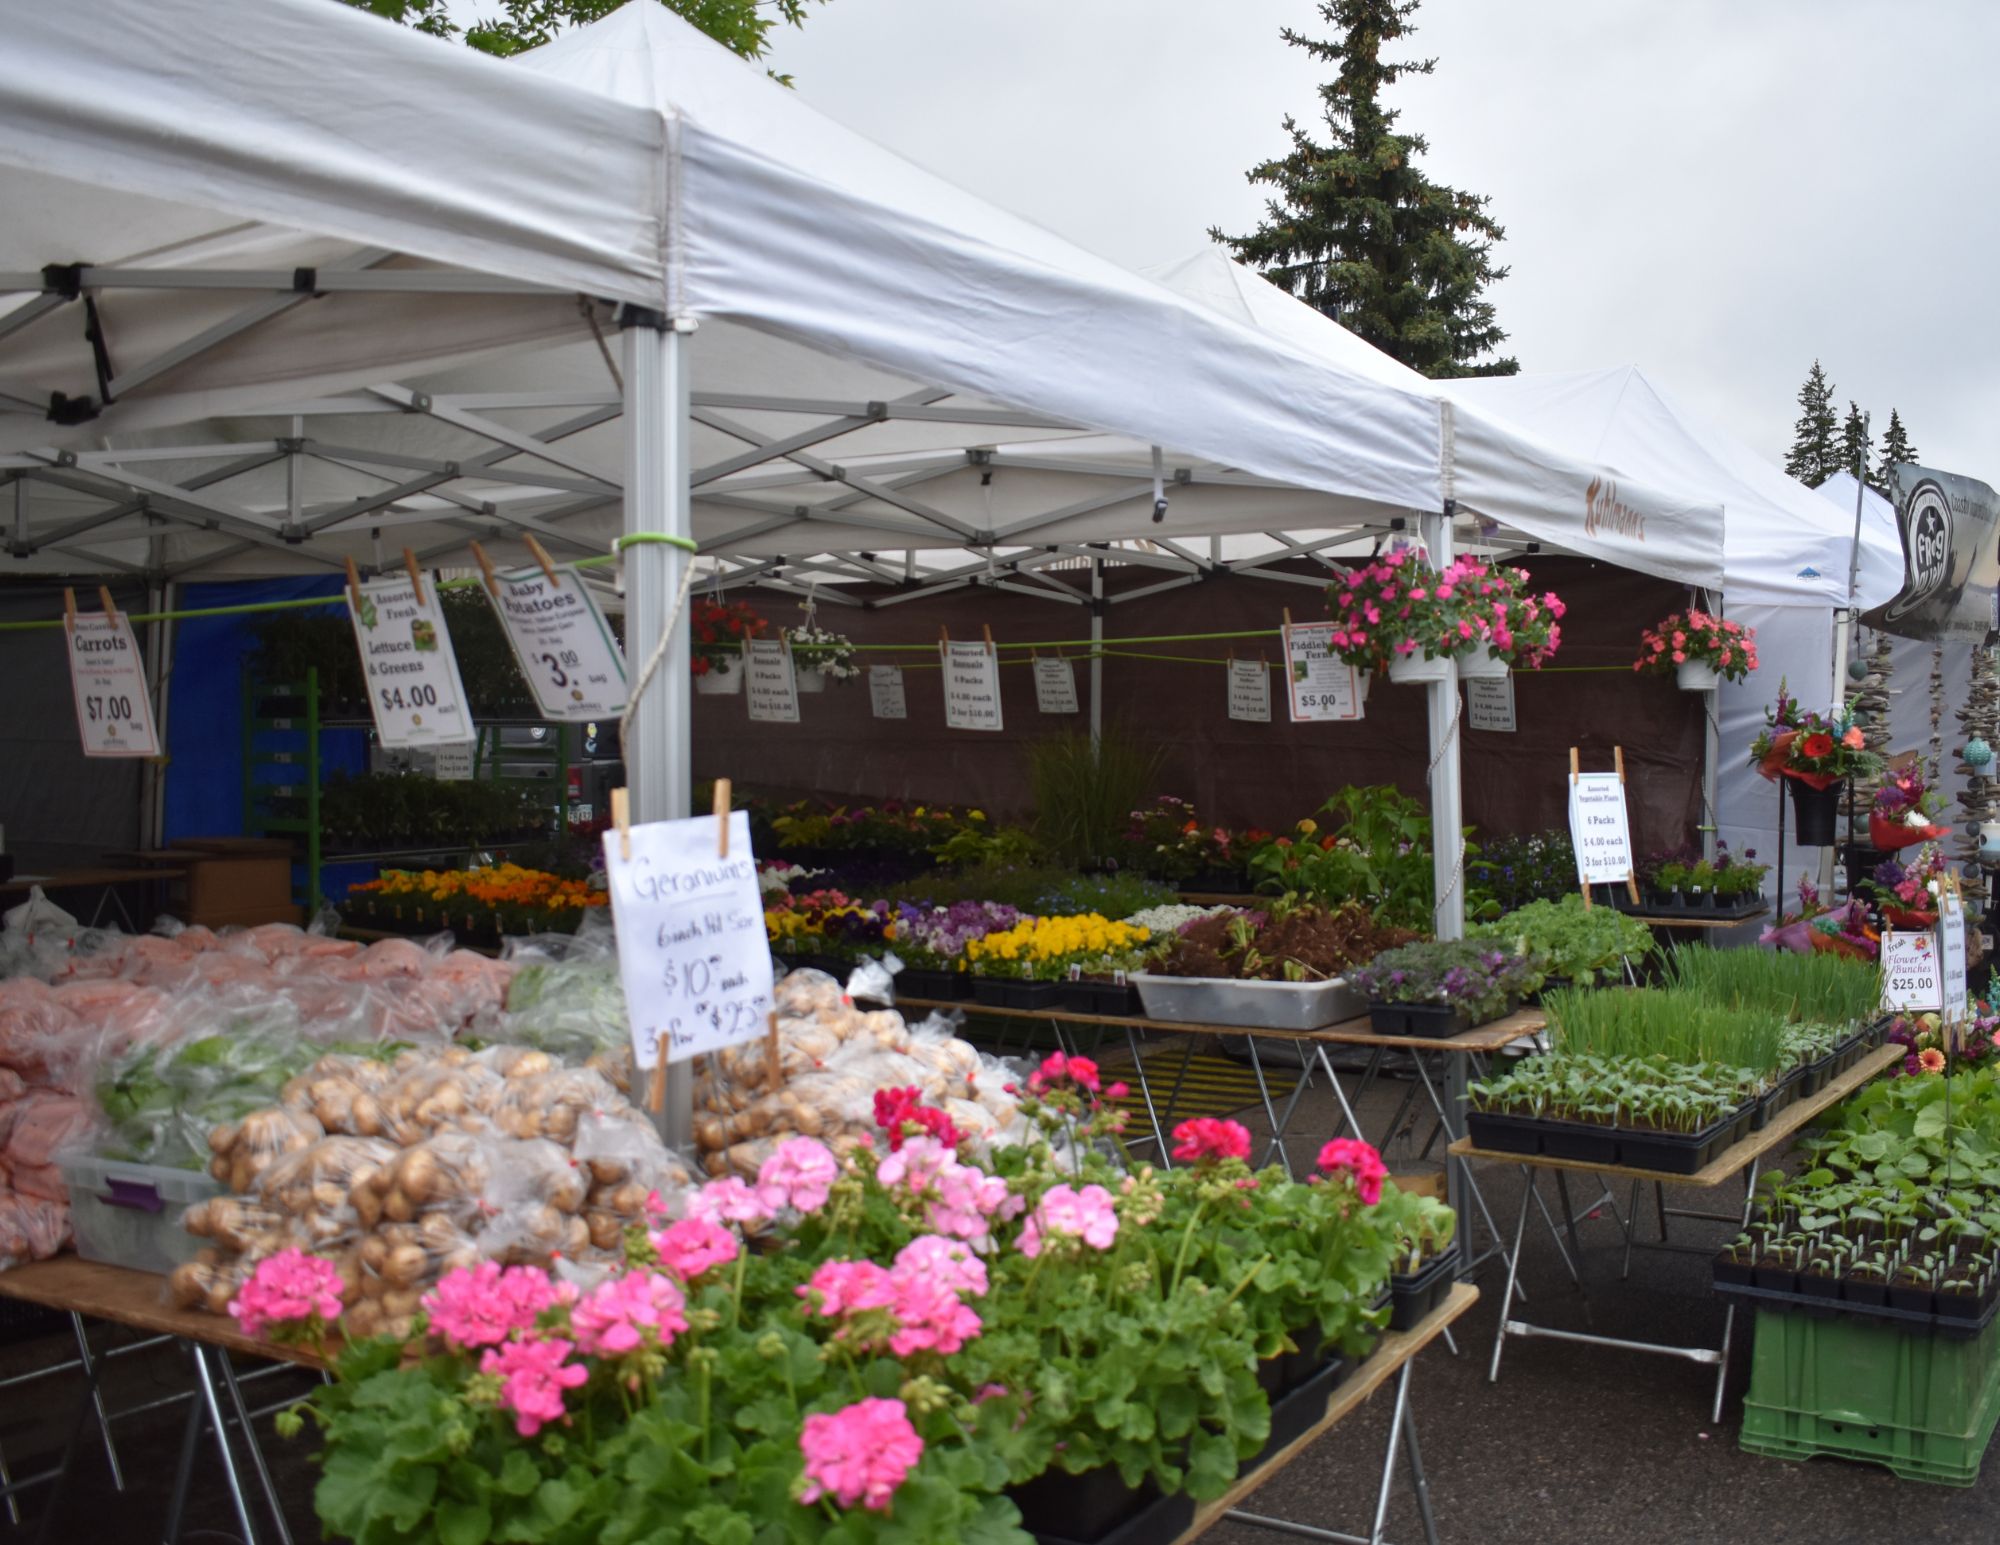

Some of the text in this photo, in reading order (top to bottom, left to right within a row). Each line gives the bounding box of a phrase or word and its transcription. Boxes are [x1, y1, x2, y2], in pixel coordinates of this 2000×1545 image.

[509, 582, 544, 597] Baby
[375, 591, 418, 606] Assorte
[503, 593, 576, 614] Potatoes
[386, 607, 418, 620] Fresh
[75, 634, 128, 652] Carrots
[368, 641, 412, 656] Lettuce
[1291, 640, 1328, 651] Fiddleh
[379, 660, 425, 675] Greens
[381, 683, 437, 711] $4.00
[1301, 695, 1336, 707] $5.00
[86, 695, 132, 722] $7.00
[1593, 816, 1616, 825] Packs
[1590, 837, 1605, 846] 4.00
[1606, 836, 1623, 845] each
[1585, 856, 1627, 867] 3 for $10.00
[632, 856, 753, 901] Geraniums
[1886, 939, 1906, 954] Fresh
[1887, 954, 1919, 964] Flower
[1895, 964, 1932, 974] Bunches
[1892, 978, 1933, 990] $25.00
